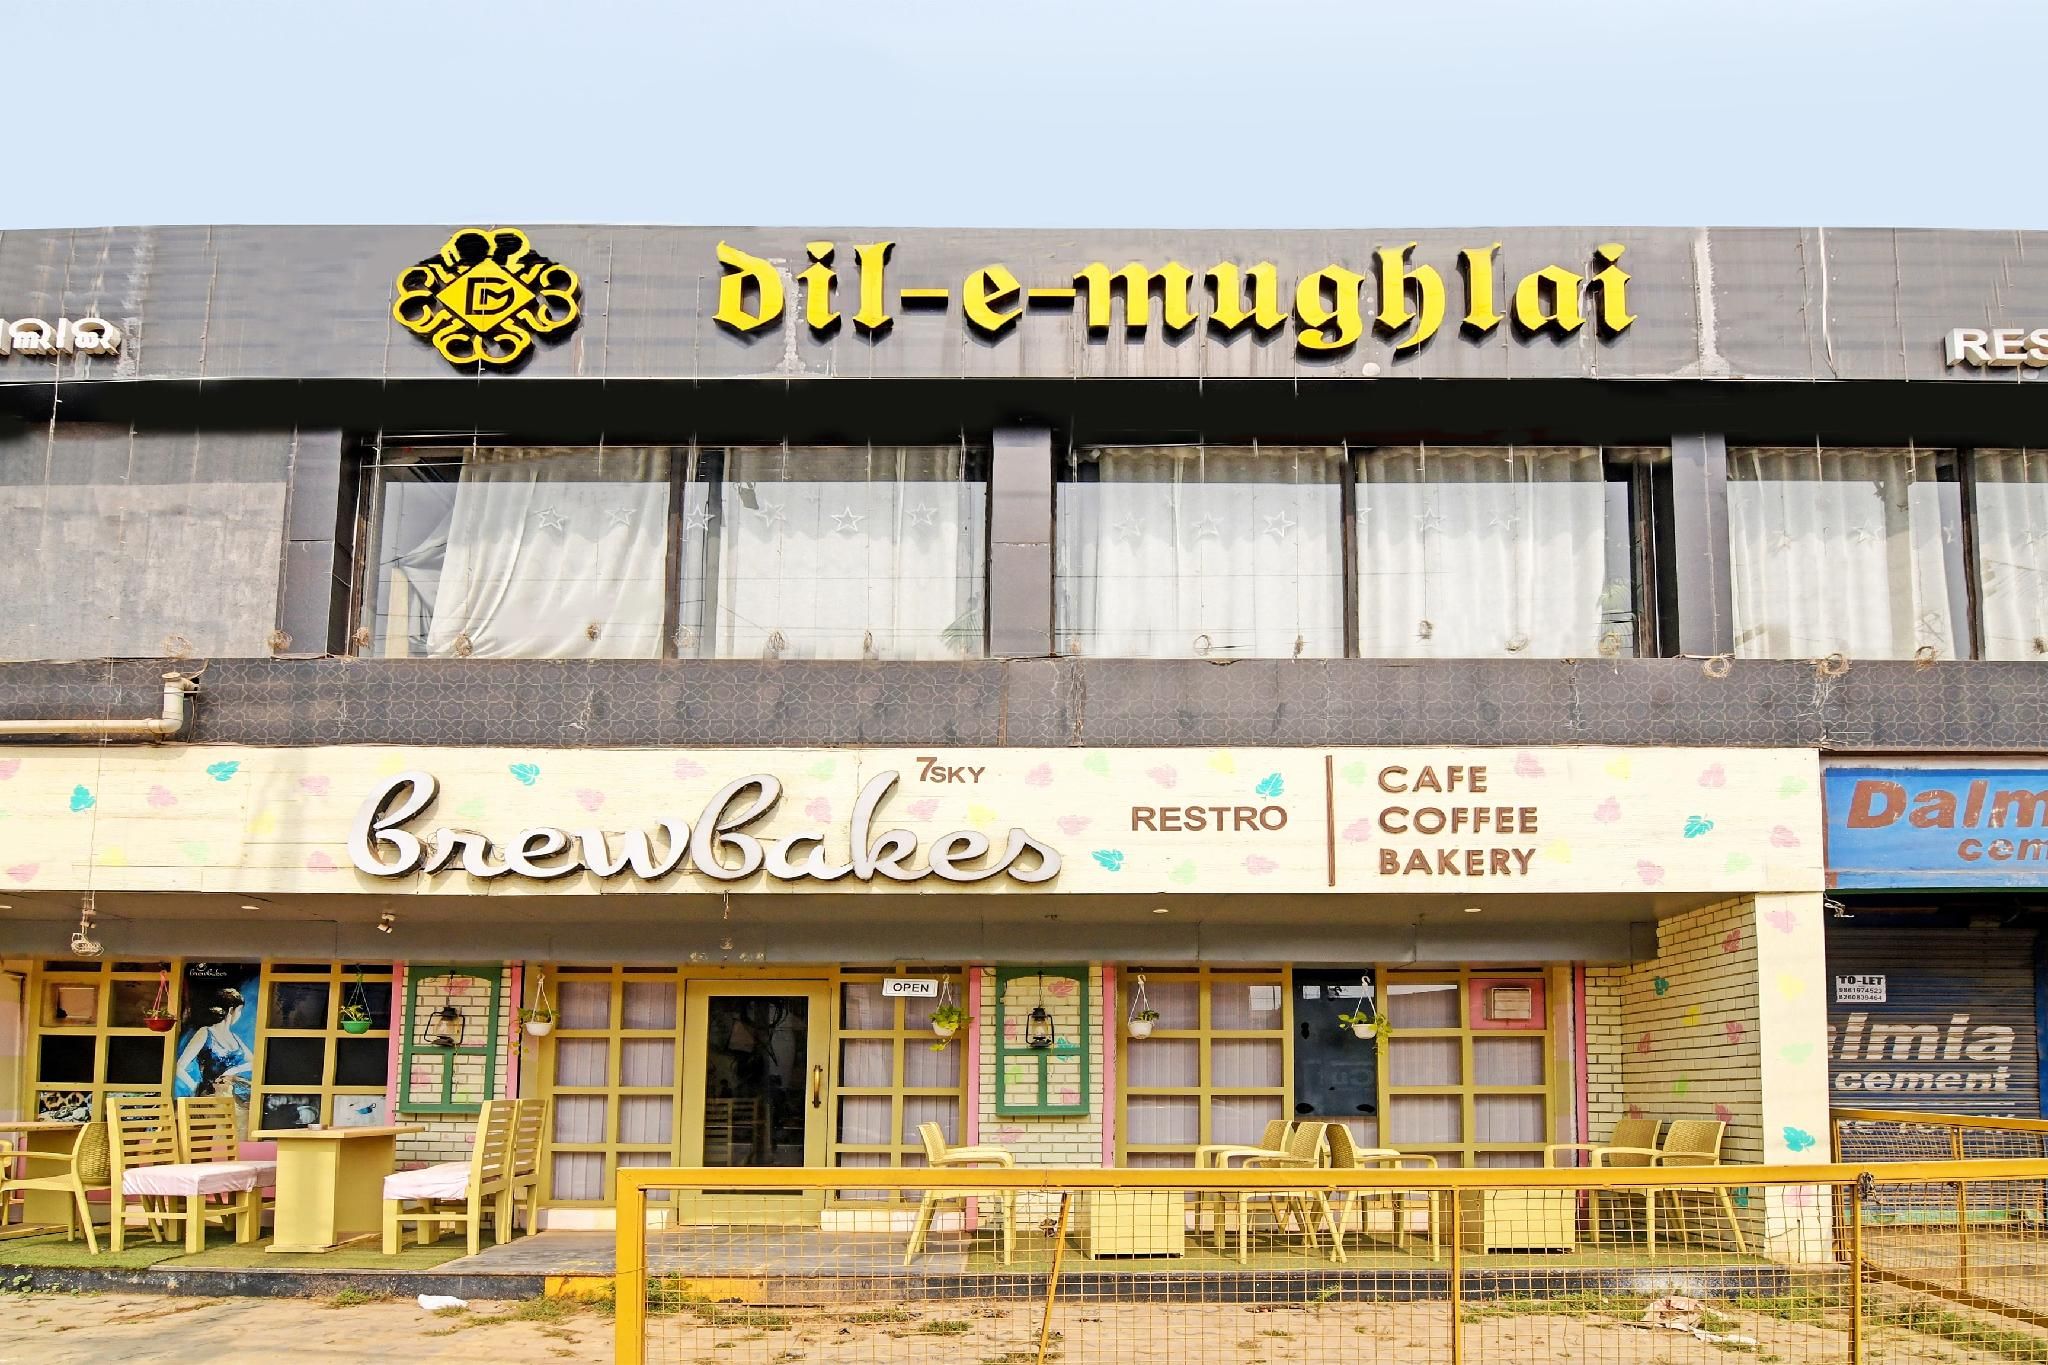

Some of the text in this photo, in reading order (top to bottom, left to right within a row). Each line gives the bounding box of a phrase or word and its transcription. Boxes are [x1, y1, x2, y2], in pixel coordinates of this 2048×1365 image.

[712, 240, 1638, 350] dil-e-mughlai
[916, 756, 986, 784] 7SKY
[1378, 765, 1488, 793] CAFE
[1131, 805, 1288, 832] RESTRO
[1847, 780, 2048, 829] Dalm
[350, 770, 1063, 883] brewbakes
[1378, 806, 1538, 834] COFFEE
[1379, 847, 1537, 877] BAKERY
[1957, 838, 2048, 862] cem
[893, 982, 929, 993] OPEN
[1838, 975, 1883, 985] TO-LET
[1828, 1012, 2016, 1061] lmia
[1834, 1066, 2011, 1092] cement
